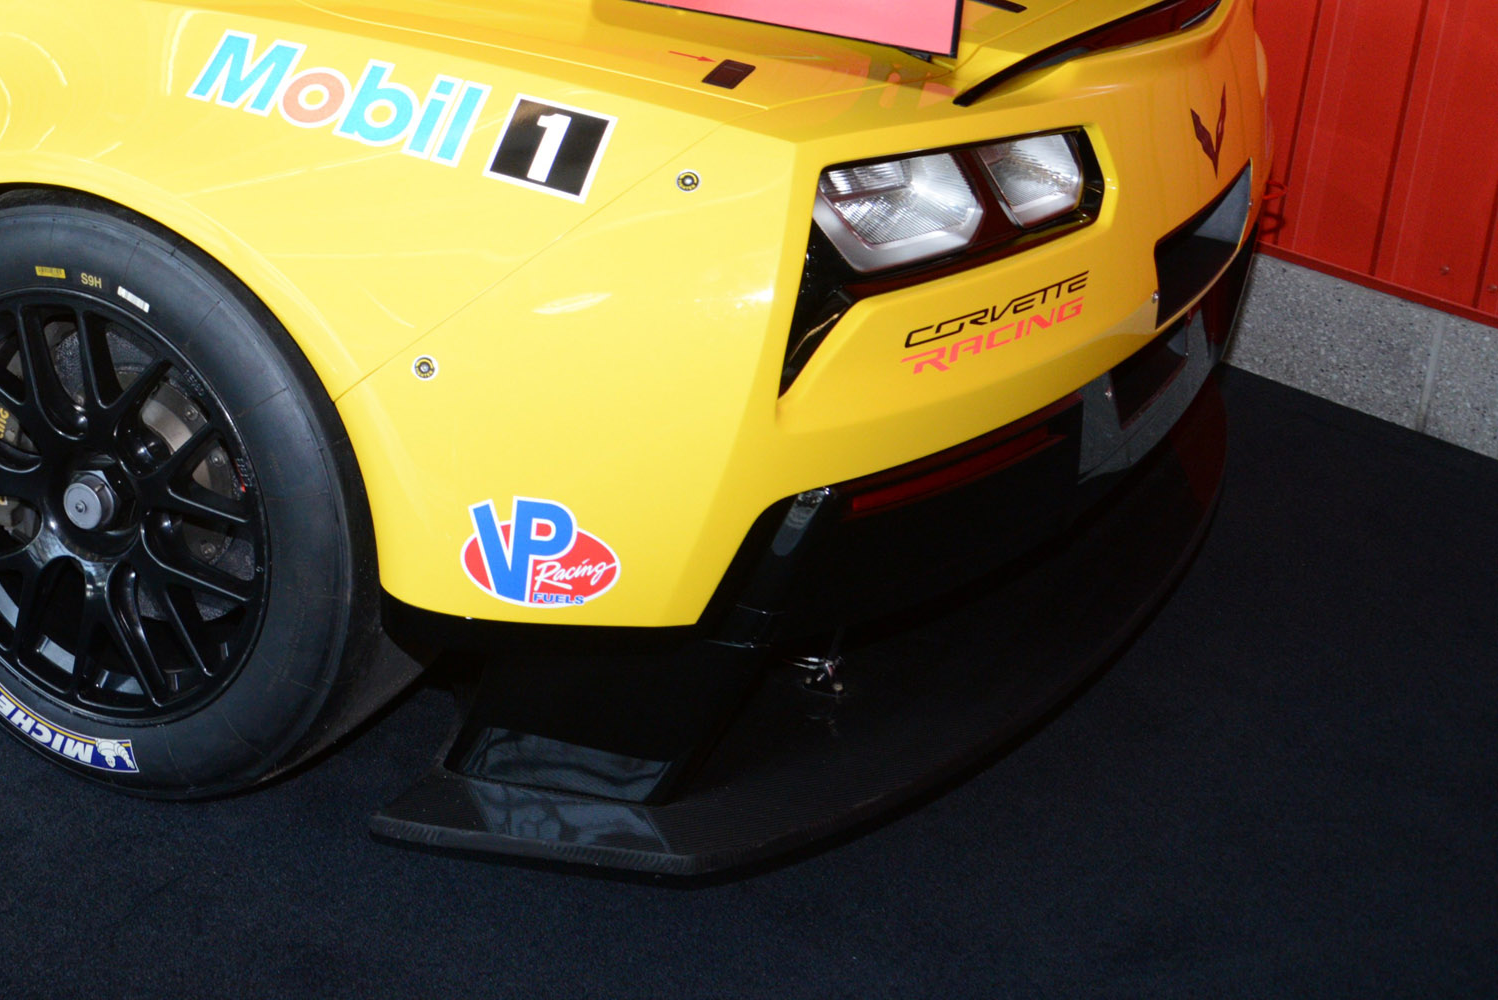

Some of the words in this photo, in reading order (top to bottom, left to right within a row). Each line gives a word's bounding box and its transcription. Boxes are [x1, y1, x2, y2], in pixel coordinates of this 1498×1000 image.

[189, 31, 489, 165] Mobil
[526, 112, 572, 183] 1
[80, 272, 102, 289] S9H
[904, 270, 1090, 348] CORVETTE
[900, 296, 1085, 375] RACING
[470, 497, 575, 603] VP
[534, 558, 617, 592] Racing
[533, 592, 585, 605] FUELS
